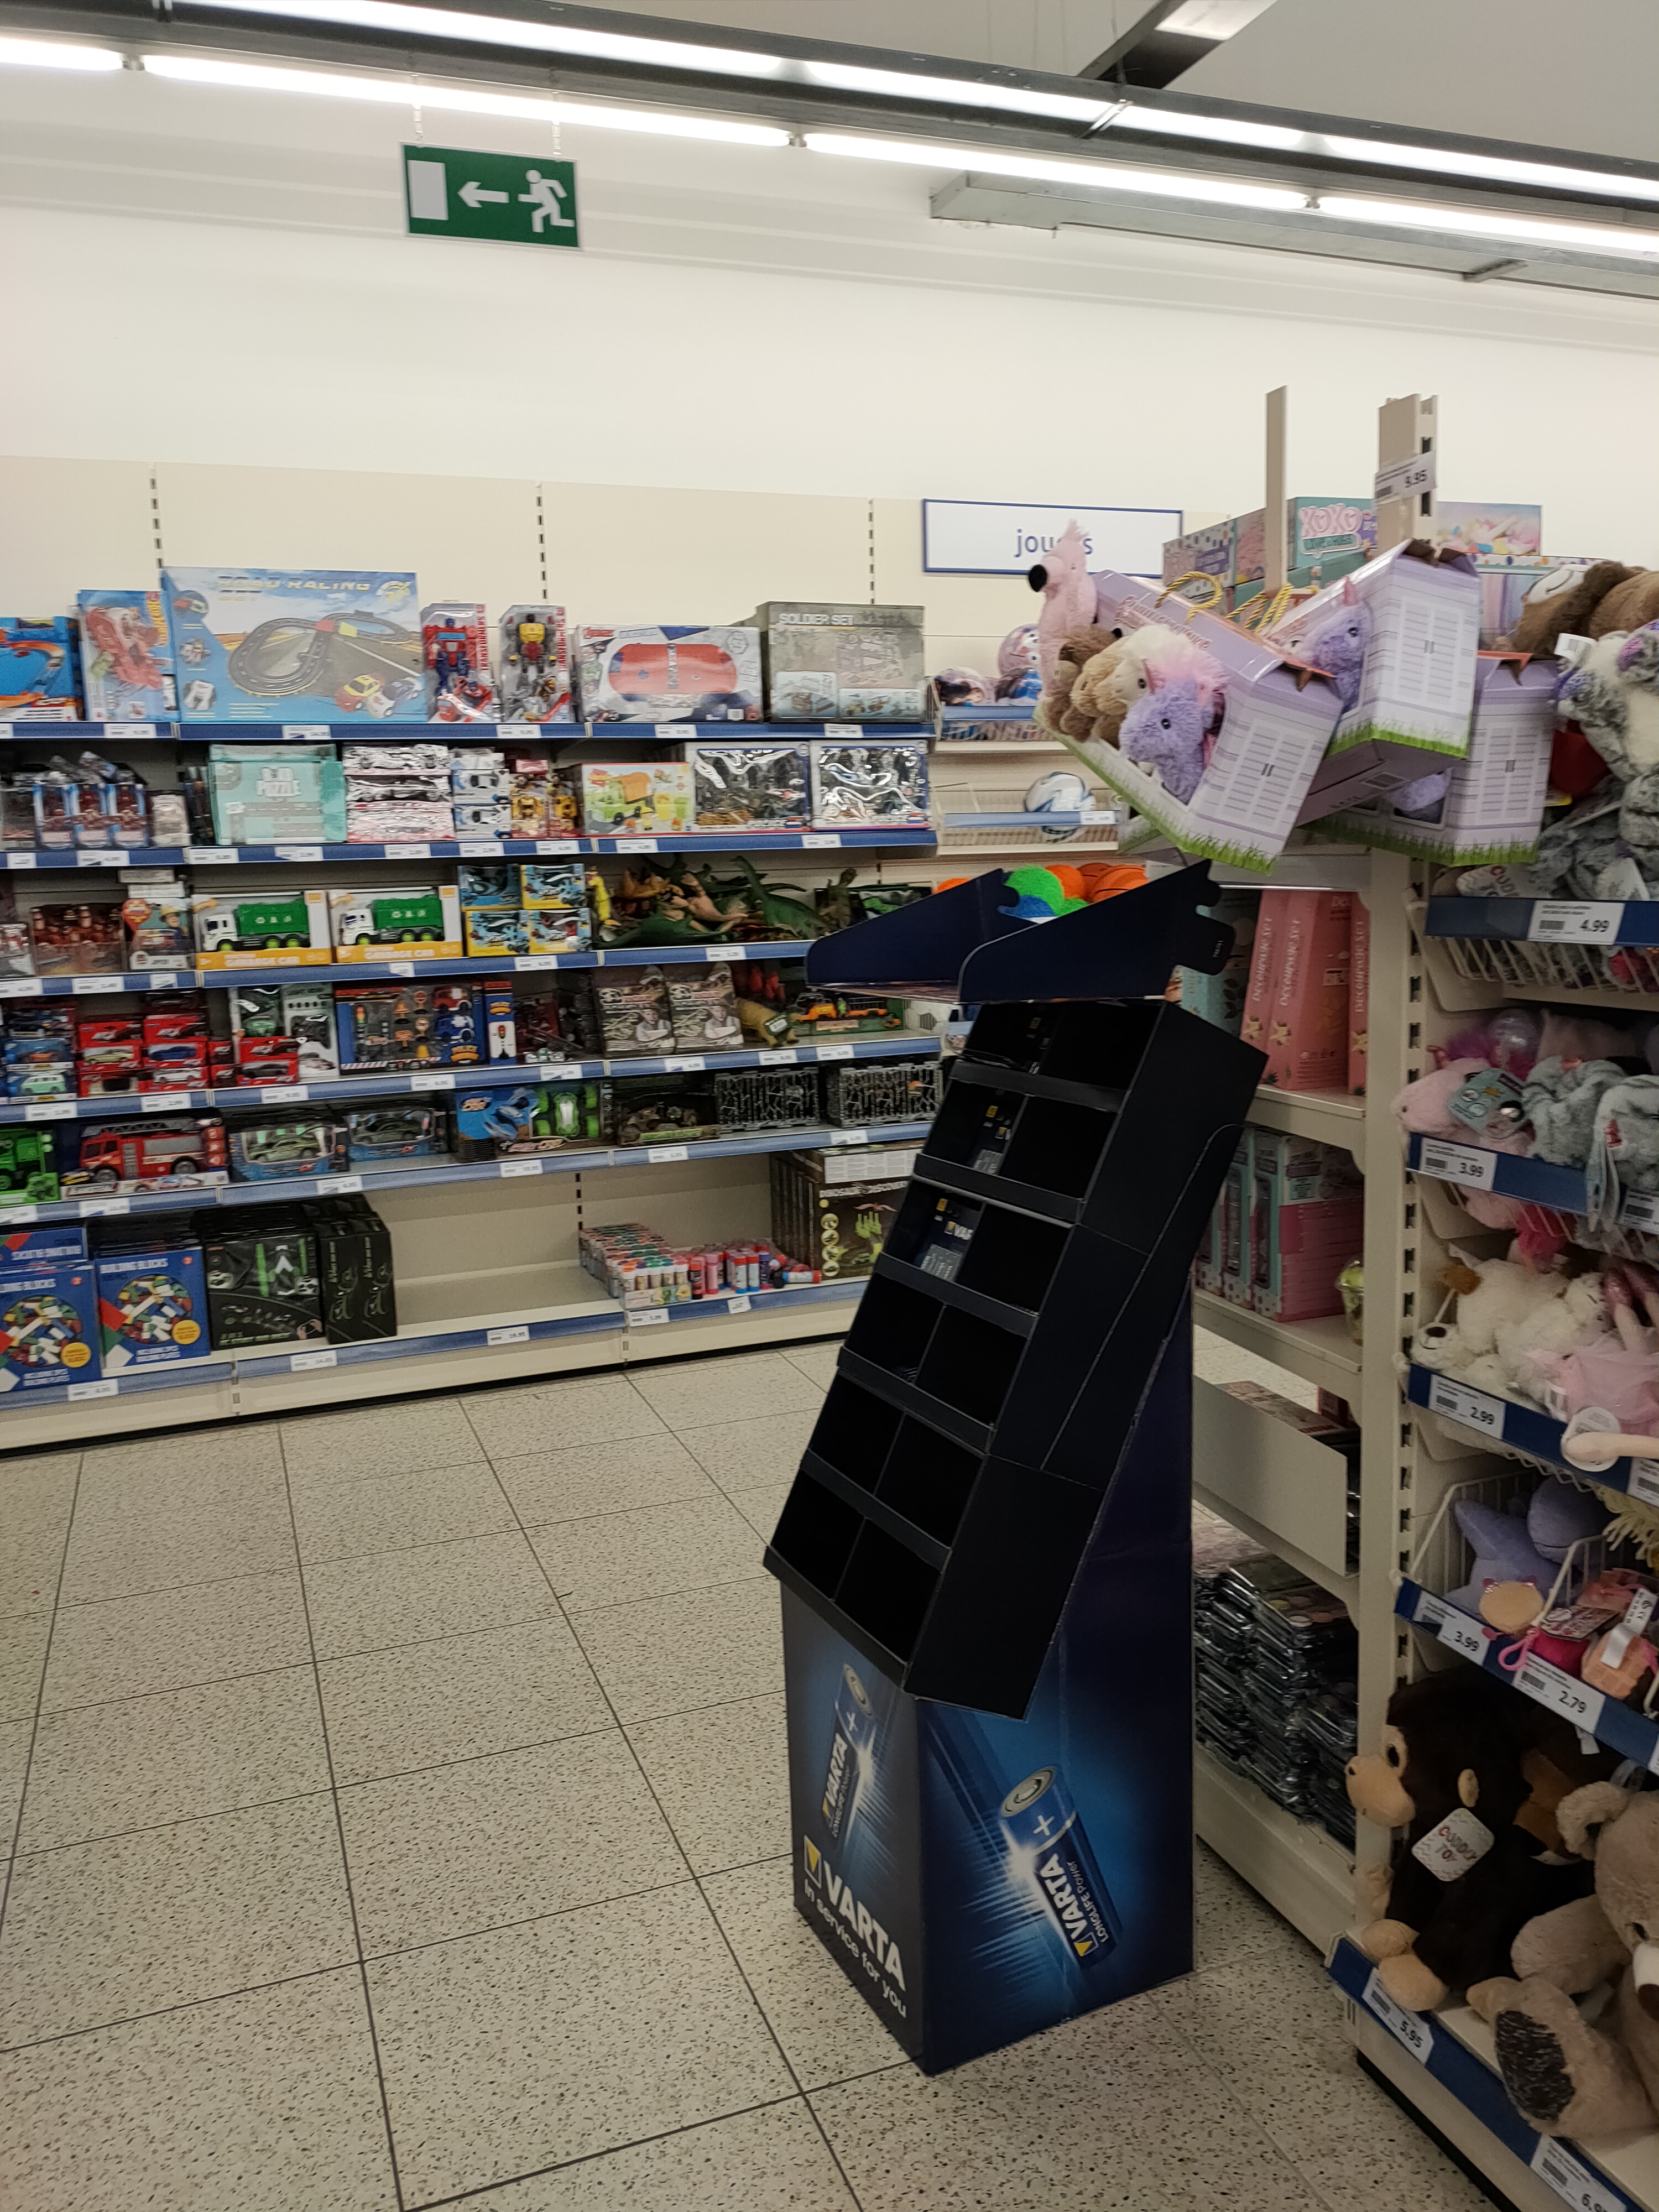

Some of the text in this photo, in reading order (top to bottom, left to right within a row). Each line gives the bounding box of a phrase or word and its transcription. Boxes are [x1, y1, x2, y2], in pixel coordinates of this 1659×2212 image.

[1299, 503, 1362, 538] XOXO
[1014, 528, 1093, 558] jous
[778, 612, 855, 626] SOLDIER SET
[1579, 919, 1610, 933] 4.99
[1458, 1162, 1485, 1178] 3.99
[1469, 1406, 1495, 1426] 2.99
[1454, 1631, 1480, 1652] 3.99
[1558, 1691, 1588, 1714] 2.79
[826, 1732, 849, 1808] VARTA
[1040, 1853, 1088, 1940] VARTA
[823, 1860, 906, 1992] VARTA
[805, 1878, 907, 2019] In service for you
[1399, 2020, 1425, 2048] 5.95
